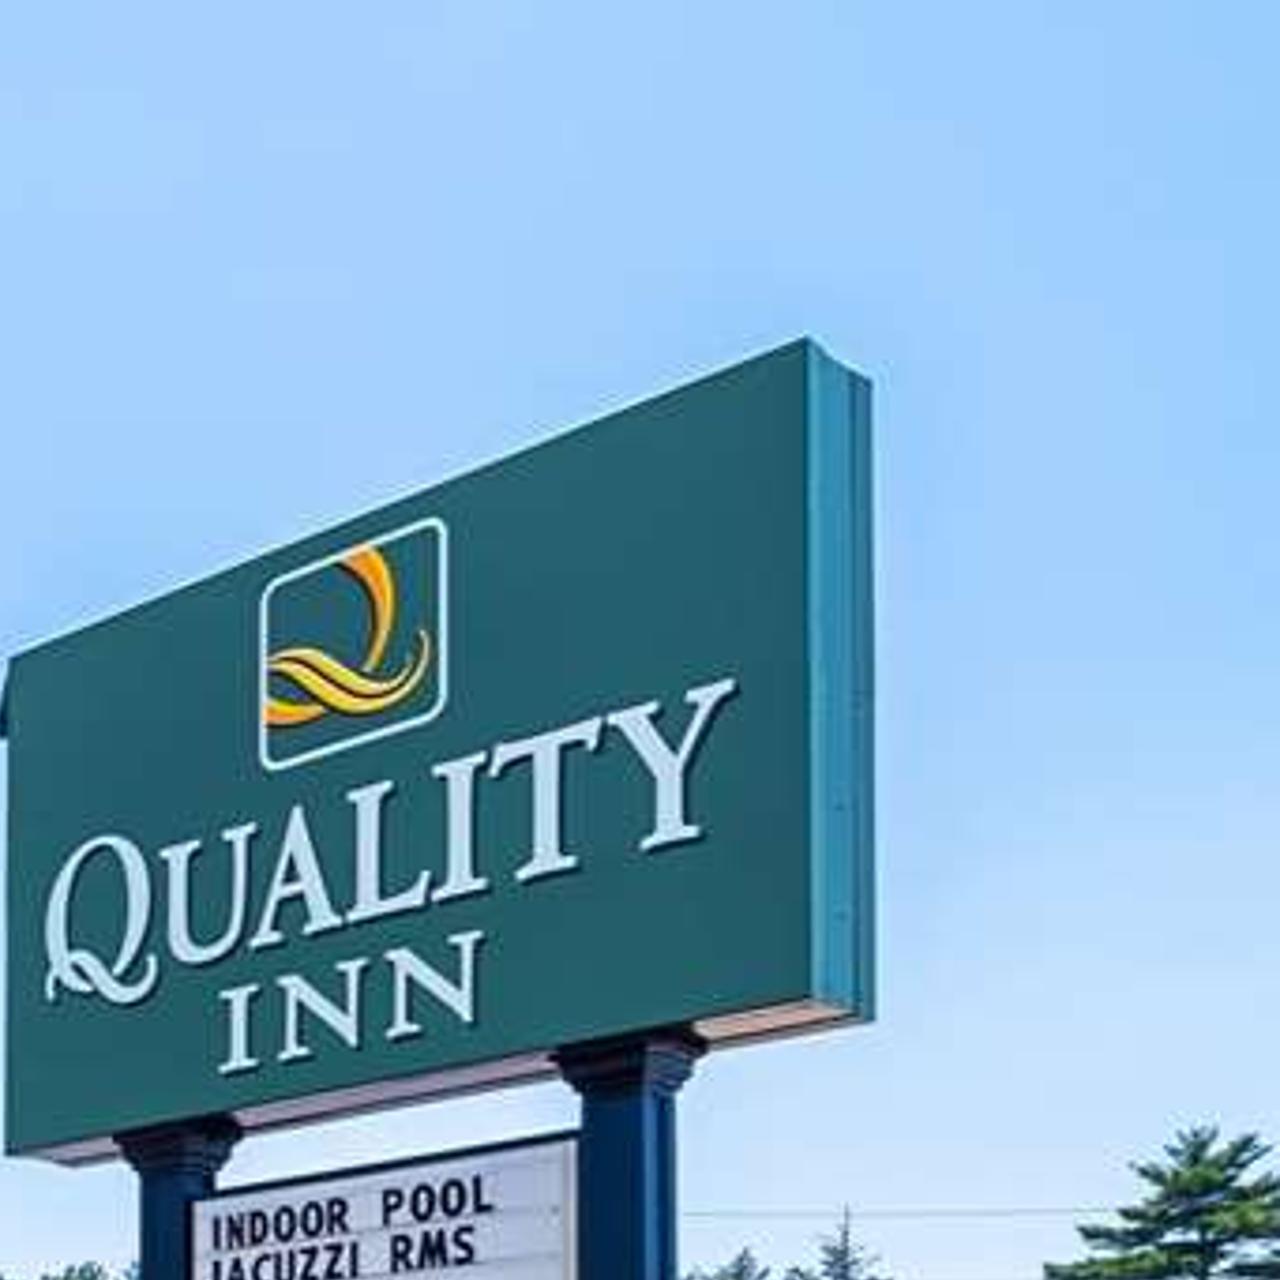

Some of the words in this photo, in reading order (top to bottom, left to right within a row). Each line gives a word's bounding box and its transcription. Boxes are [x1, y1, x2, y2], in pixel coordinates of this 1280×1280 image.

[45, 676, 737, 1005] QUALITY
[217, 929, 485, 1076] INN
[212, 1197, 350, 1252] INDOOR
[382, 1174, 494, 1228] POOL
[390, 1225, 476, 1274] RMS
